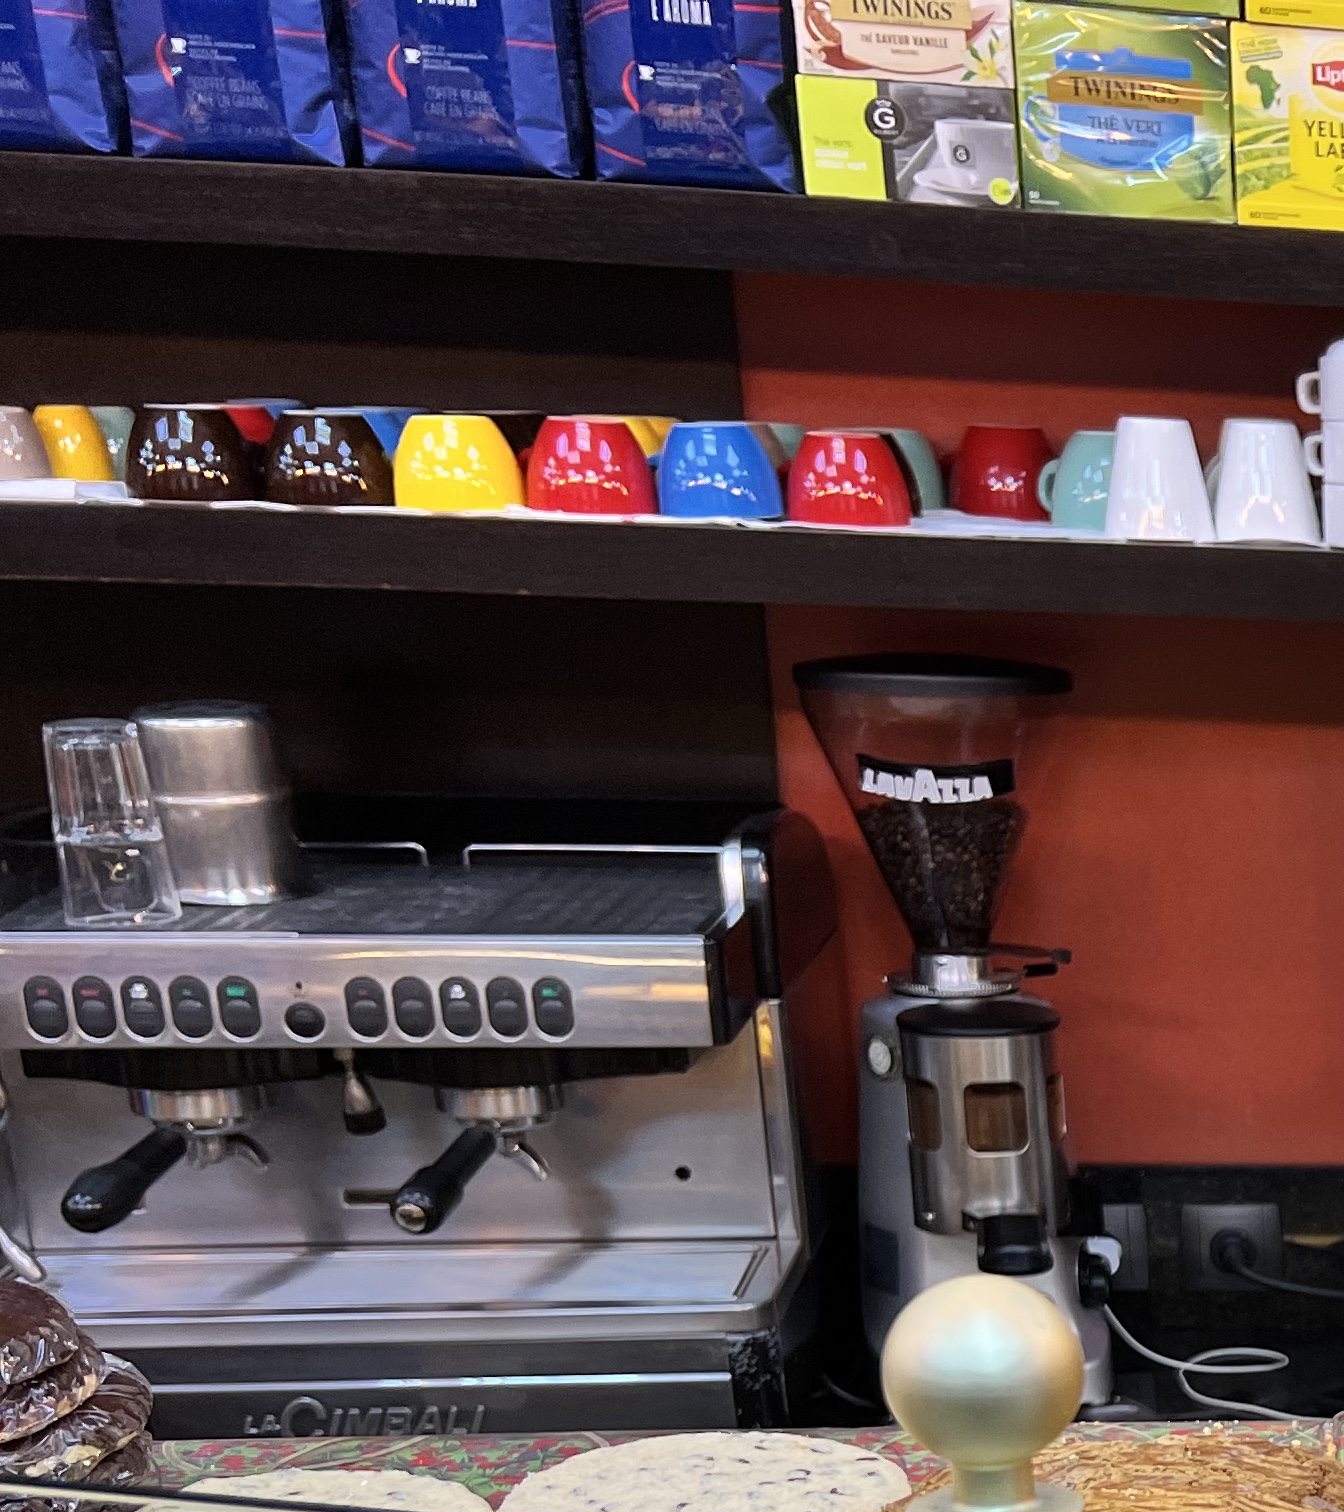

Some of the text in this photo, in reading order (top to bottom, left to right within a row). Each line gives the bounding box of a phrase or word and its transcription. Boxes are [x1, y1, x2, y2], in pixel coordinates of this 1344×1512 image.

[861, 767, 994, 804] LAVAZZA
[243, 1396, 486, 1437] LA CIMBALI
